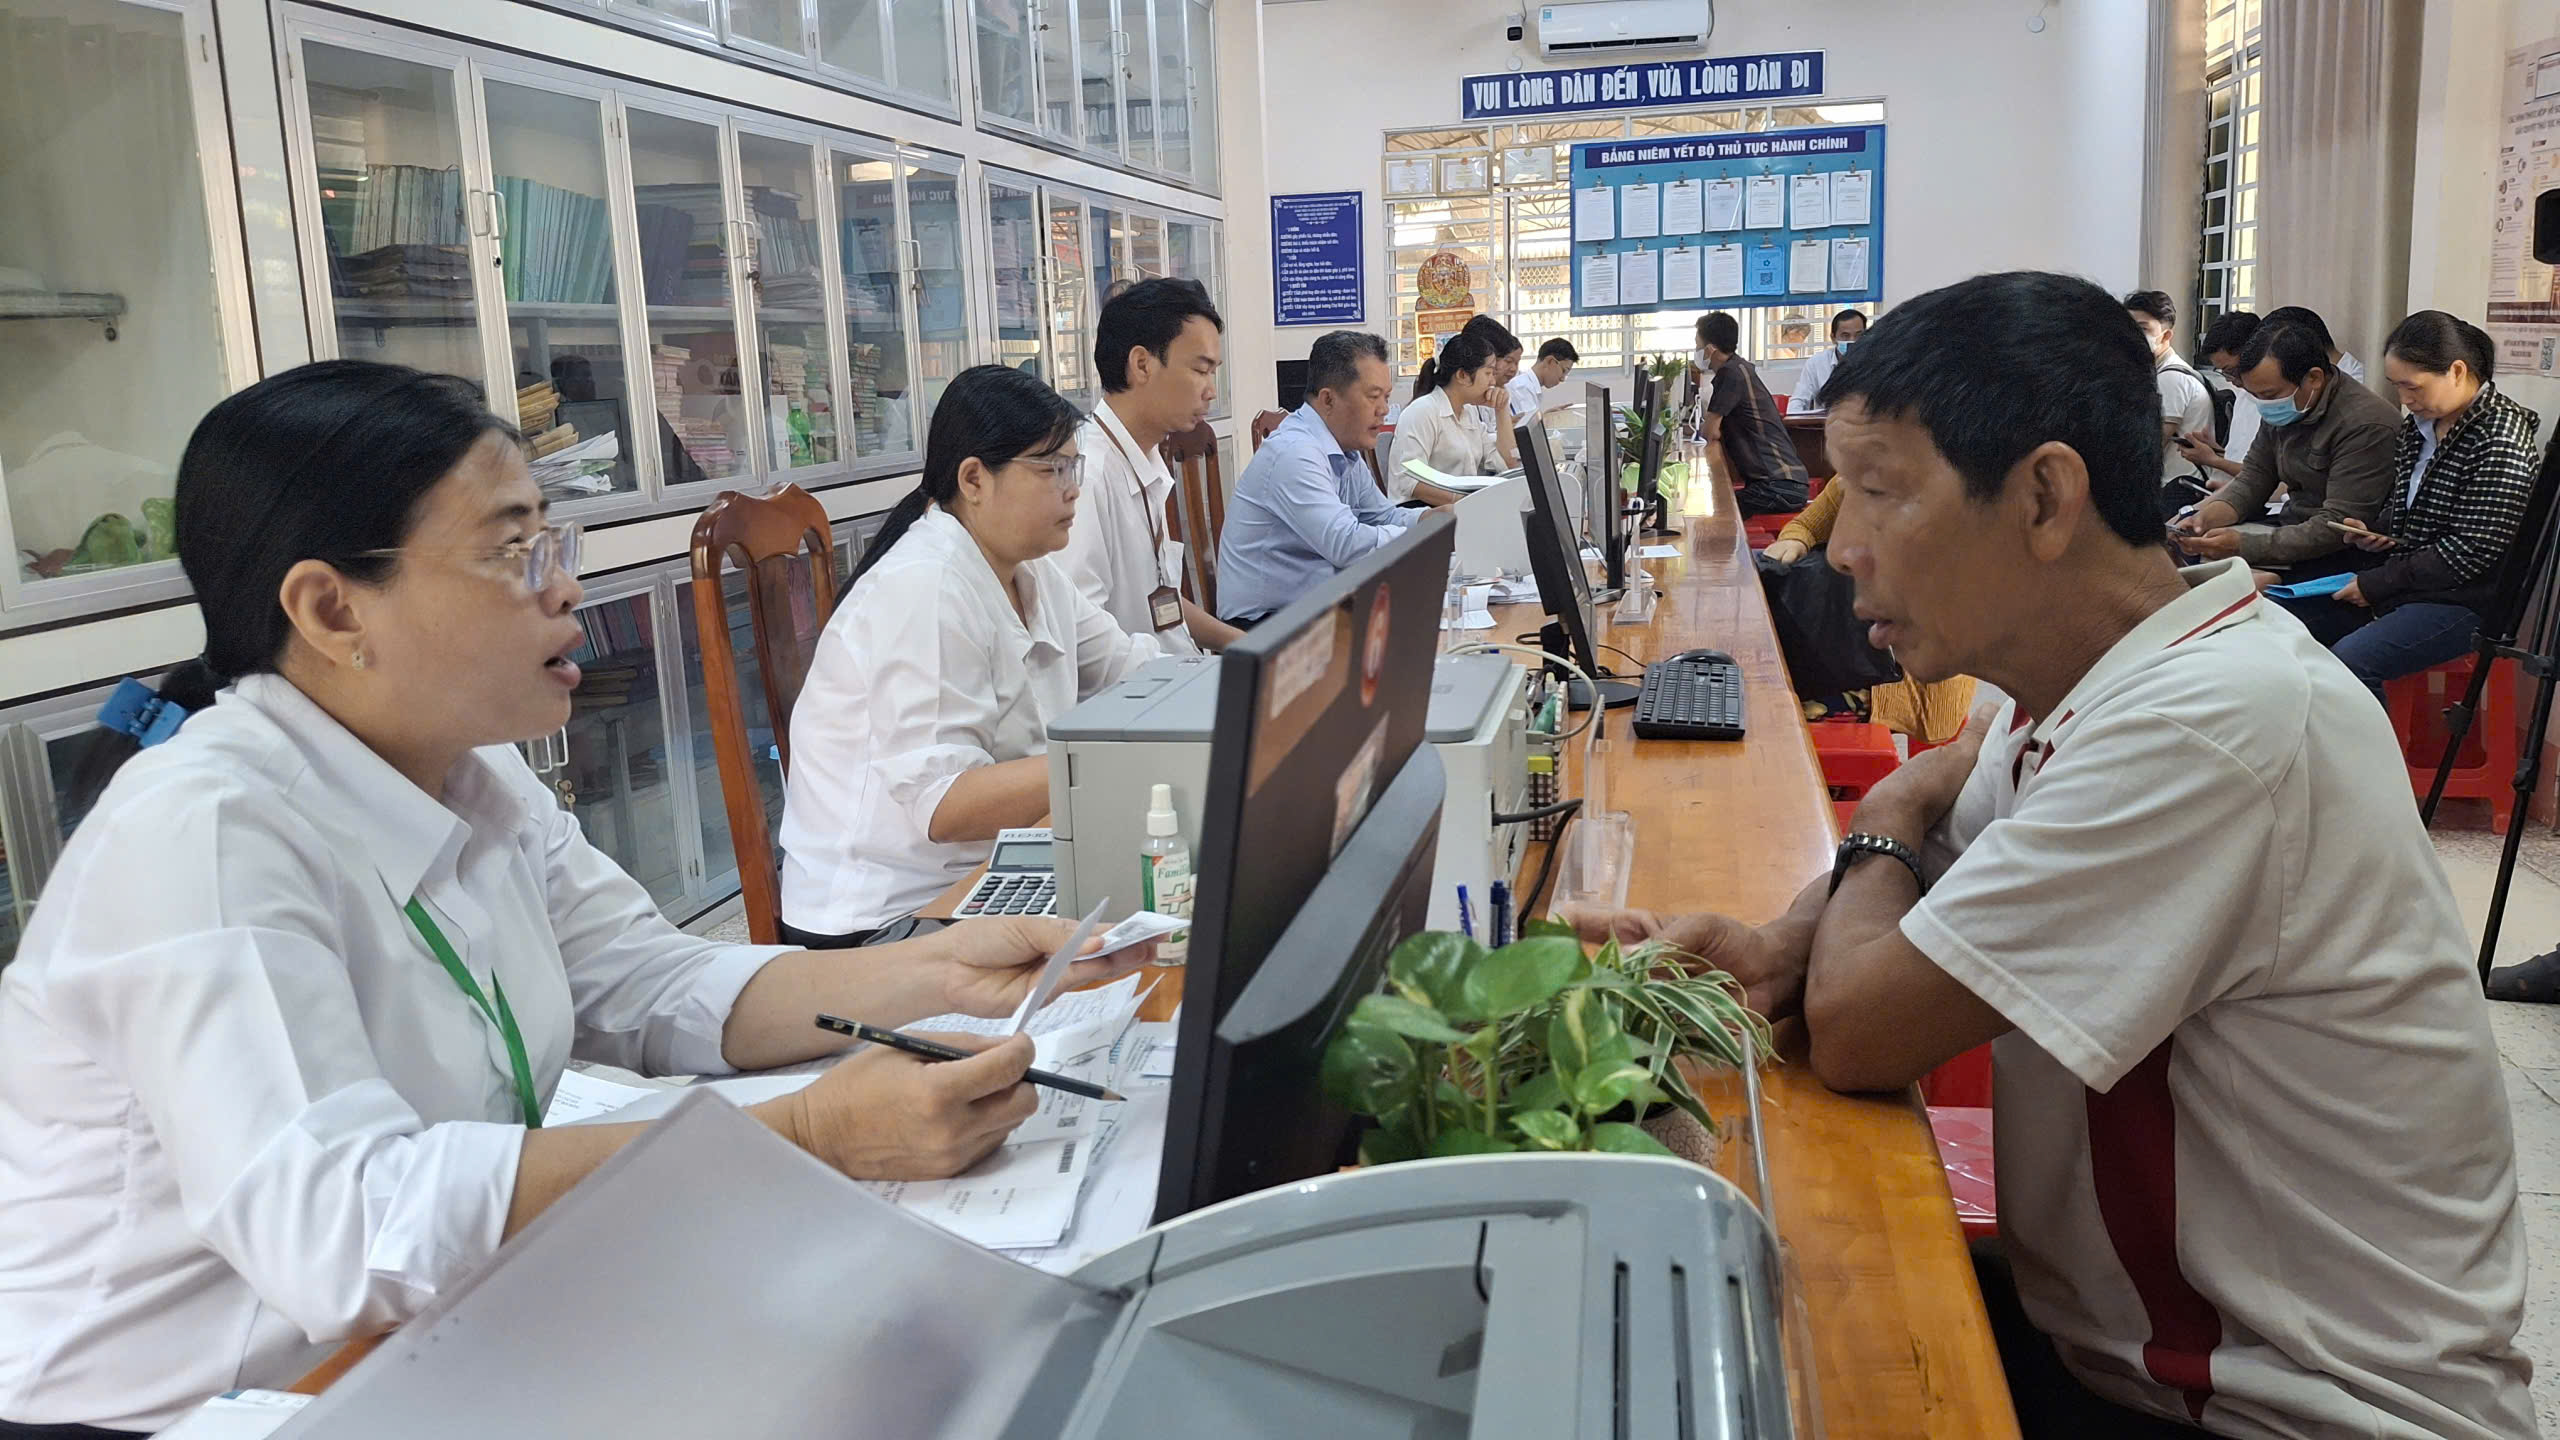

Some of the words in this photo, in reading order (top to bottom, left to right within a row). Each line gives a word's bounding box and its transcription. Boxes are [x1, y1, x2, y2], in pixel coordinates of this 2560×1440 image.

[1472, 81, 1501, 110] VUI
[1508, 74, 1554, 107] LÒNG
[1561, 72, 1595, 104] DÂN
[1649, 63, 1682, 98] VỪA
[1690, 60, 1738, 95] LÒNG
[1746, 58, 1782, 91] DÂN
[1791, 60, 1810, 88] ĐI
[1601, 146, 1635, 163] BẢNG
[1638, 147, 1670, 161] NIÊM
[1673, 142, 1695, 158] YẾT
[1698, 145, 1715, 159] BỘ
[1718, 140, 1742, 156] THỦ
[1745, 141, 1769, 155] TỤC
[1771, 137, 1806, 153] HÀNH
[1809, 136, 1848, 150] CHÍNH
